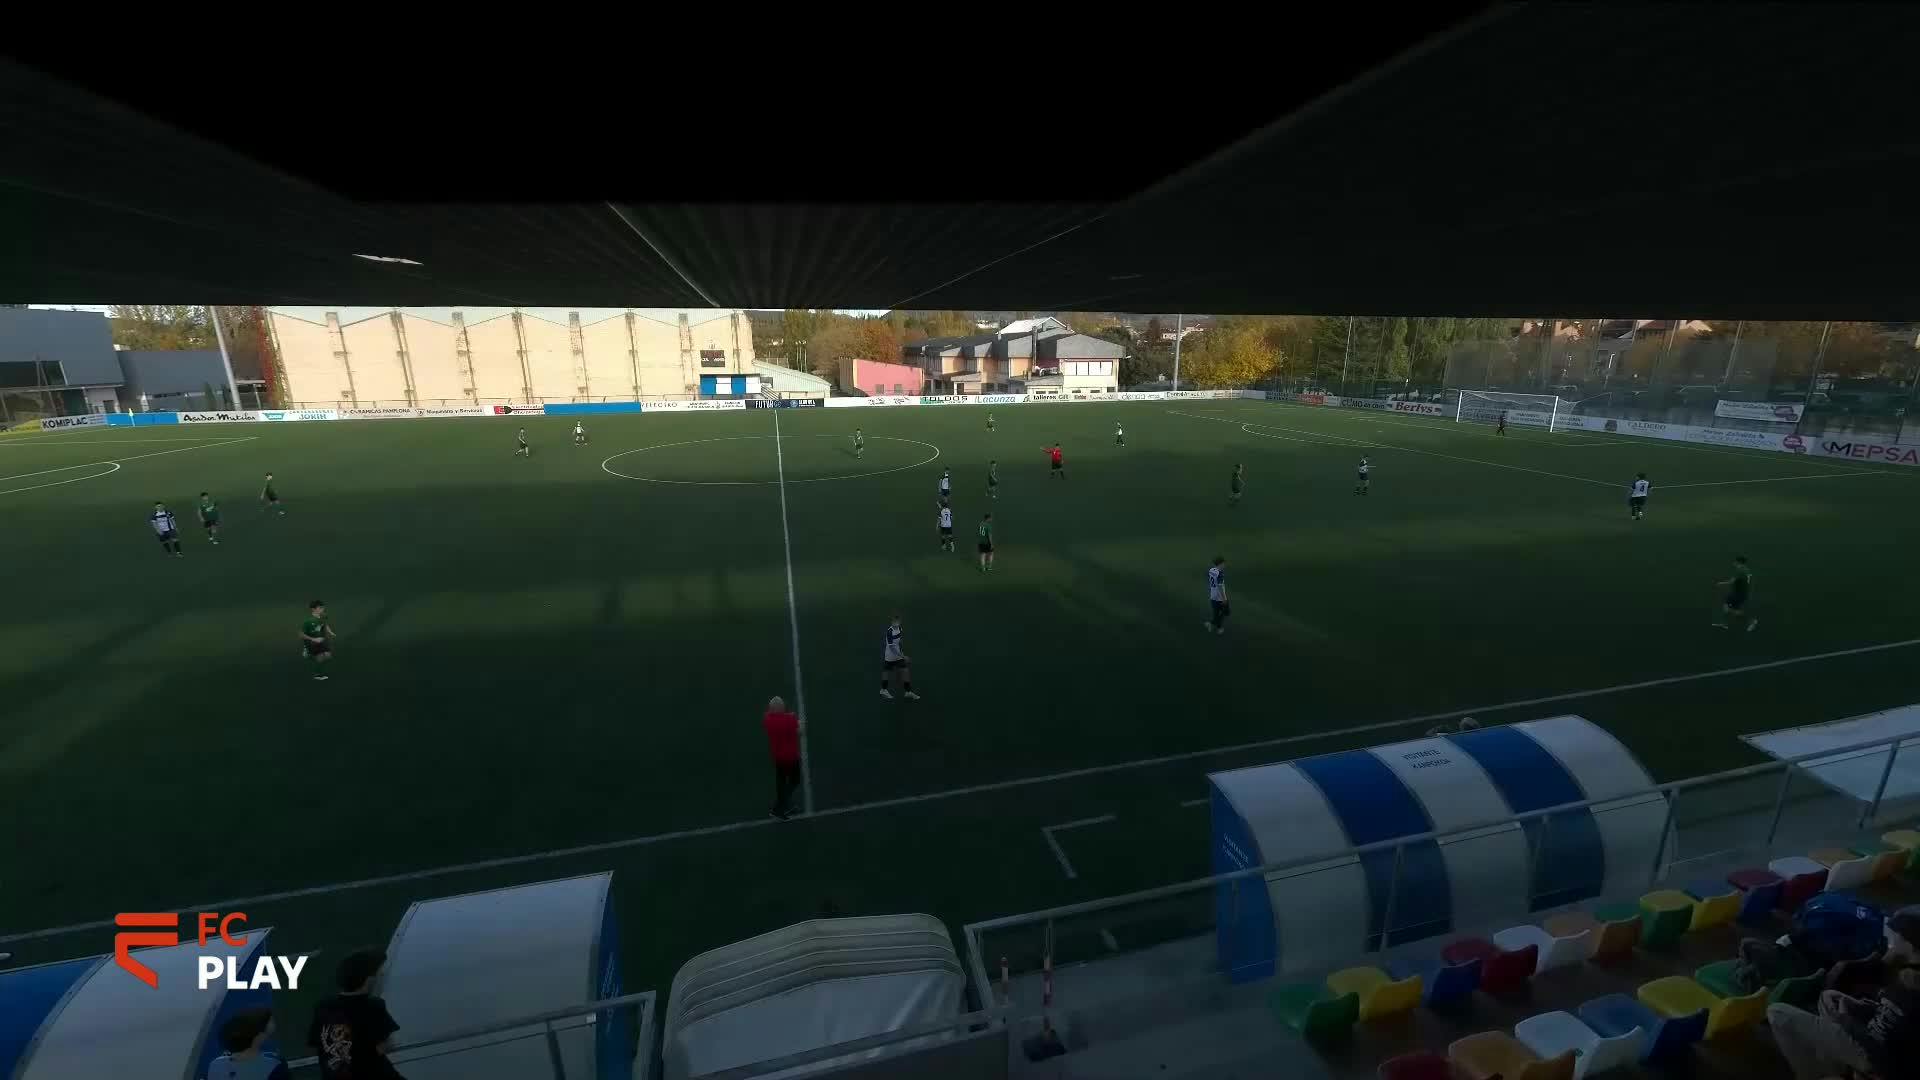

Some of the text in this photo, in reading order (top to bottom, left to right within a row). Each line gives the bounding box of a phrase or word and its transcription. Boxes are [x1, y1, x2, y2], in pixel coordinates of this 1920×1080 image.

[1395, 402, 1433, 414] Berlys
[41, 416, 88, 429] KOMIPLAC
[1830, 441, 1918, 465] MEPSA
